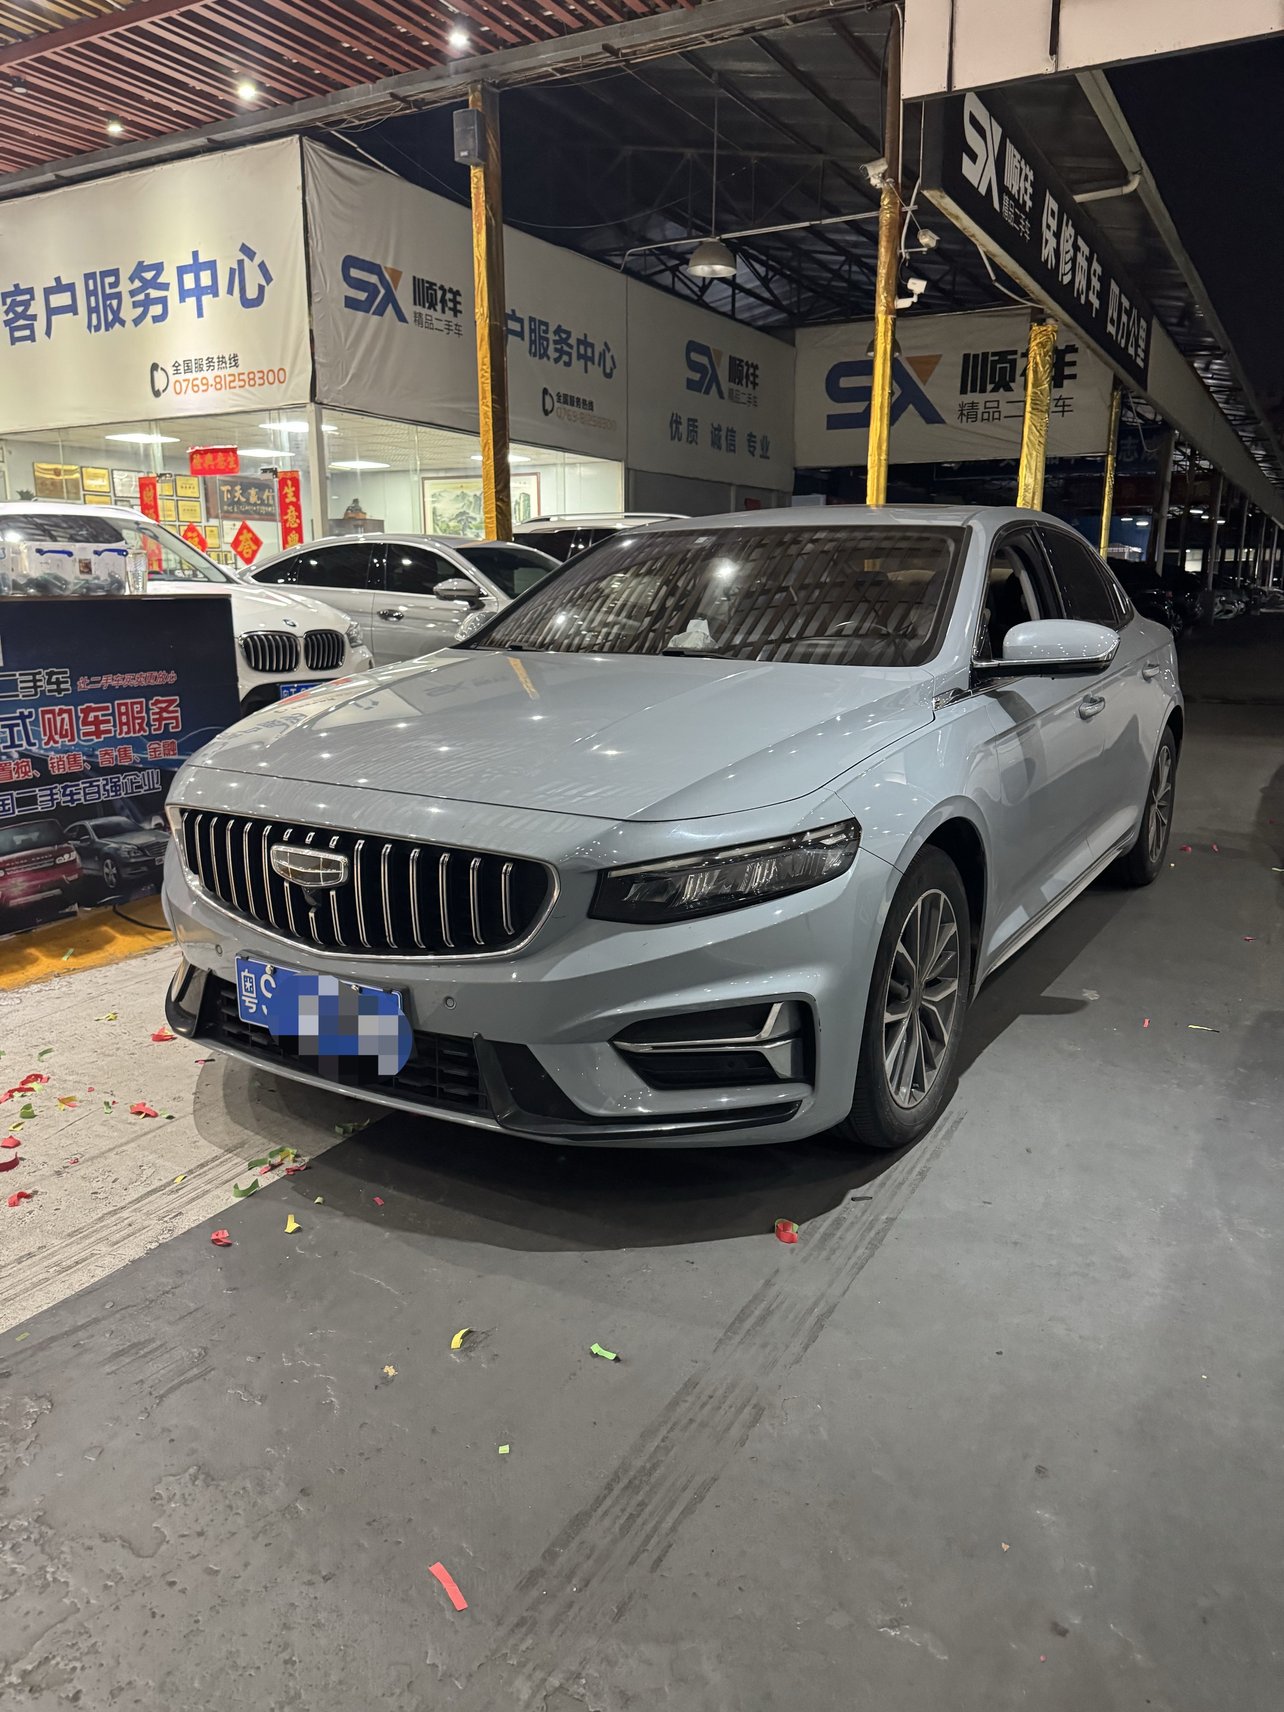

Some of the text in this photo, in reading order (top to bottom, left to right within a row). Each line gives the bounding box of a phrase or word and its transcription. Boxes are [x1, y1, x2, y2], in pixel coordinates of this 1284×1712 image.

[1004, 137, 1035, 213] 顺祥
[1002, 192, 1031, 244] 精品二手车
[1, 242, 273, 346] 客户服务中心
[412, 275, 463, 318] 顺祥
[1041, 189, 1148, 369] 保修两年 四万公里
[413, 311, 464, 338] 精品二手车
[171, 353, 240, 376] 全国服务热线
[728, 354, 759, 390] 顺祥
[957, 395, 1075, 424] 精品二车
[669, 412, 770, 460] 优质 诚信 专业
[0, 668, 72, 700] 二手车
[147, 739, 178, 761] 金融
